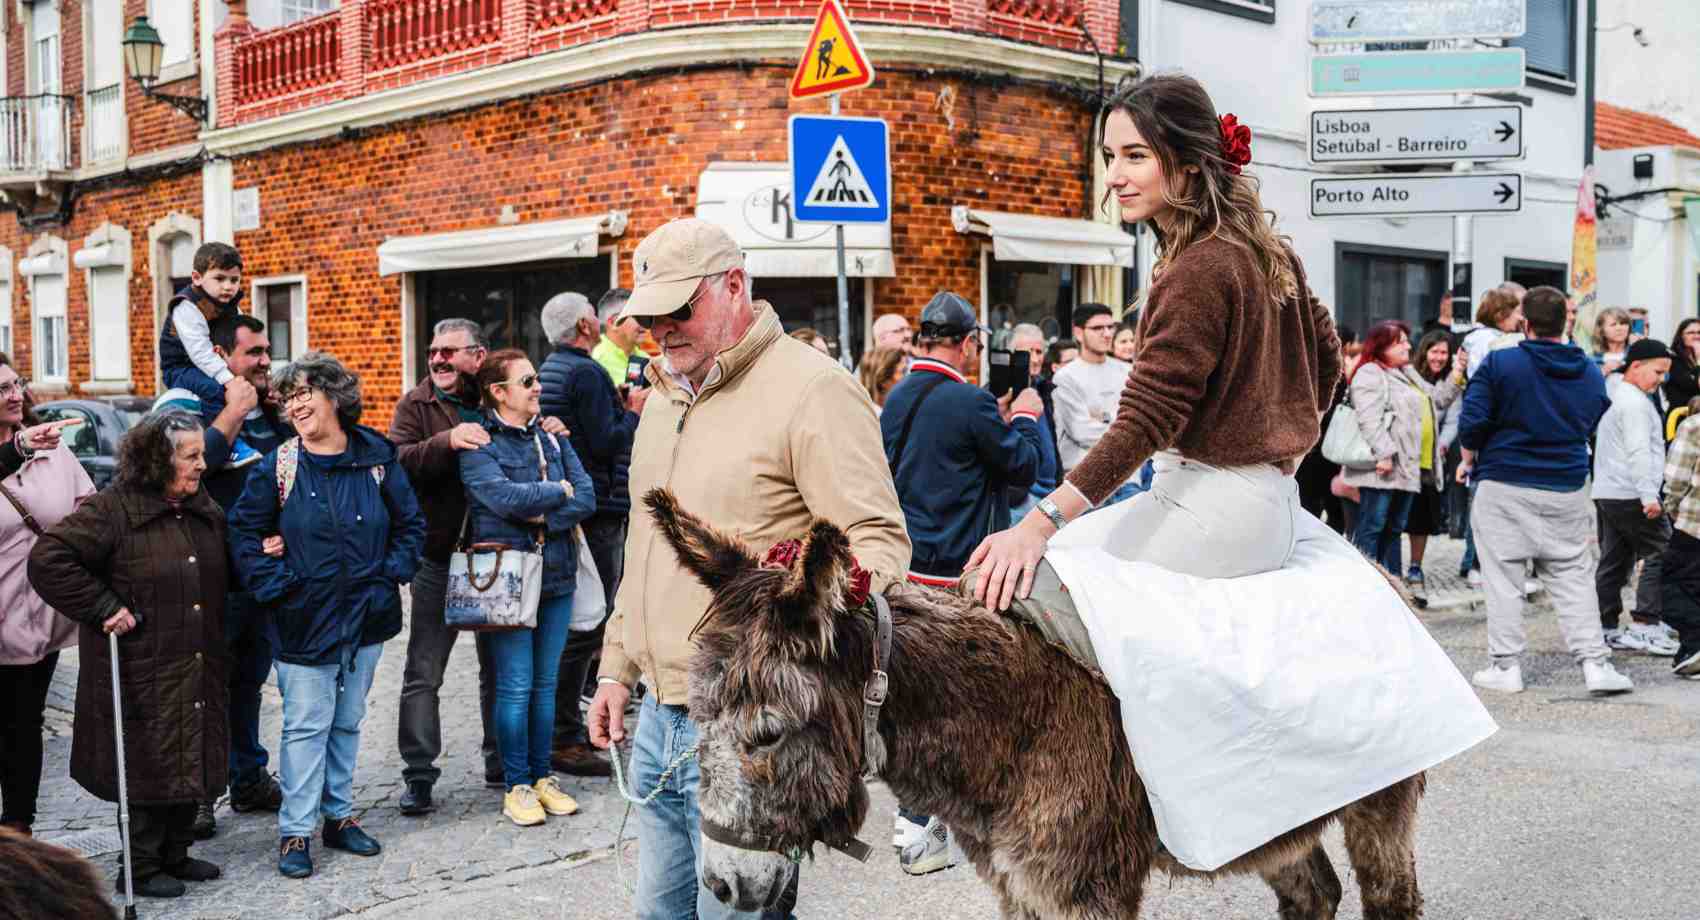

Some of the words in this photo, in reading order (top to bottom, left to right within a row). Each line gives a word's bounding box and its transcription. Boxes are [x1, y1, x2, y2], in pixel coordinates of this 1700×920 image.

[1315, 119, 1370, 134] Lisboa
[1398, 137, 1468, 152] Barreiro
[1315, 188, 1364, 202] Porto
[1372, 186, 1409, 201] Alto
